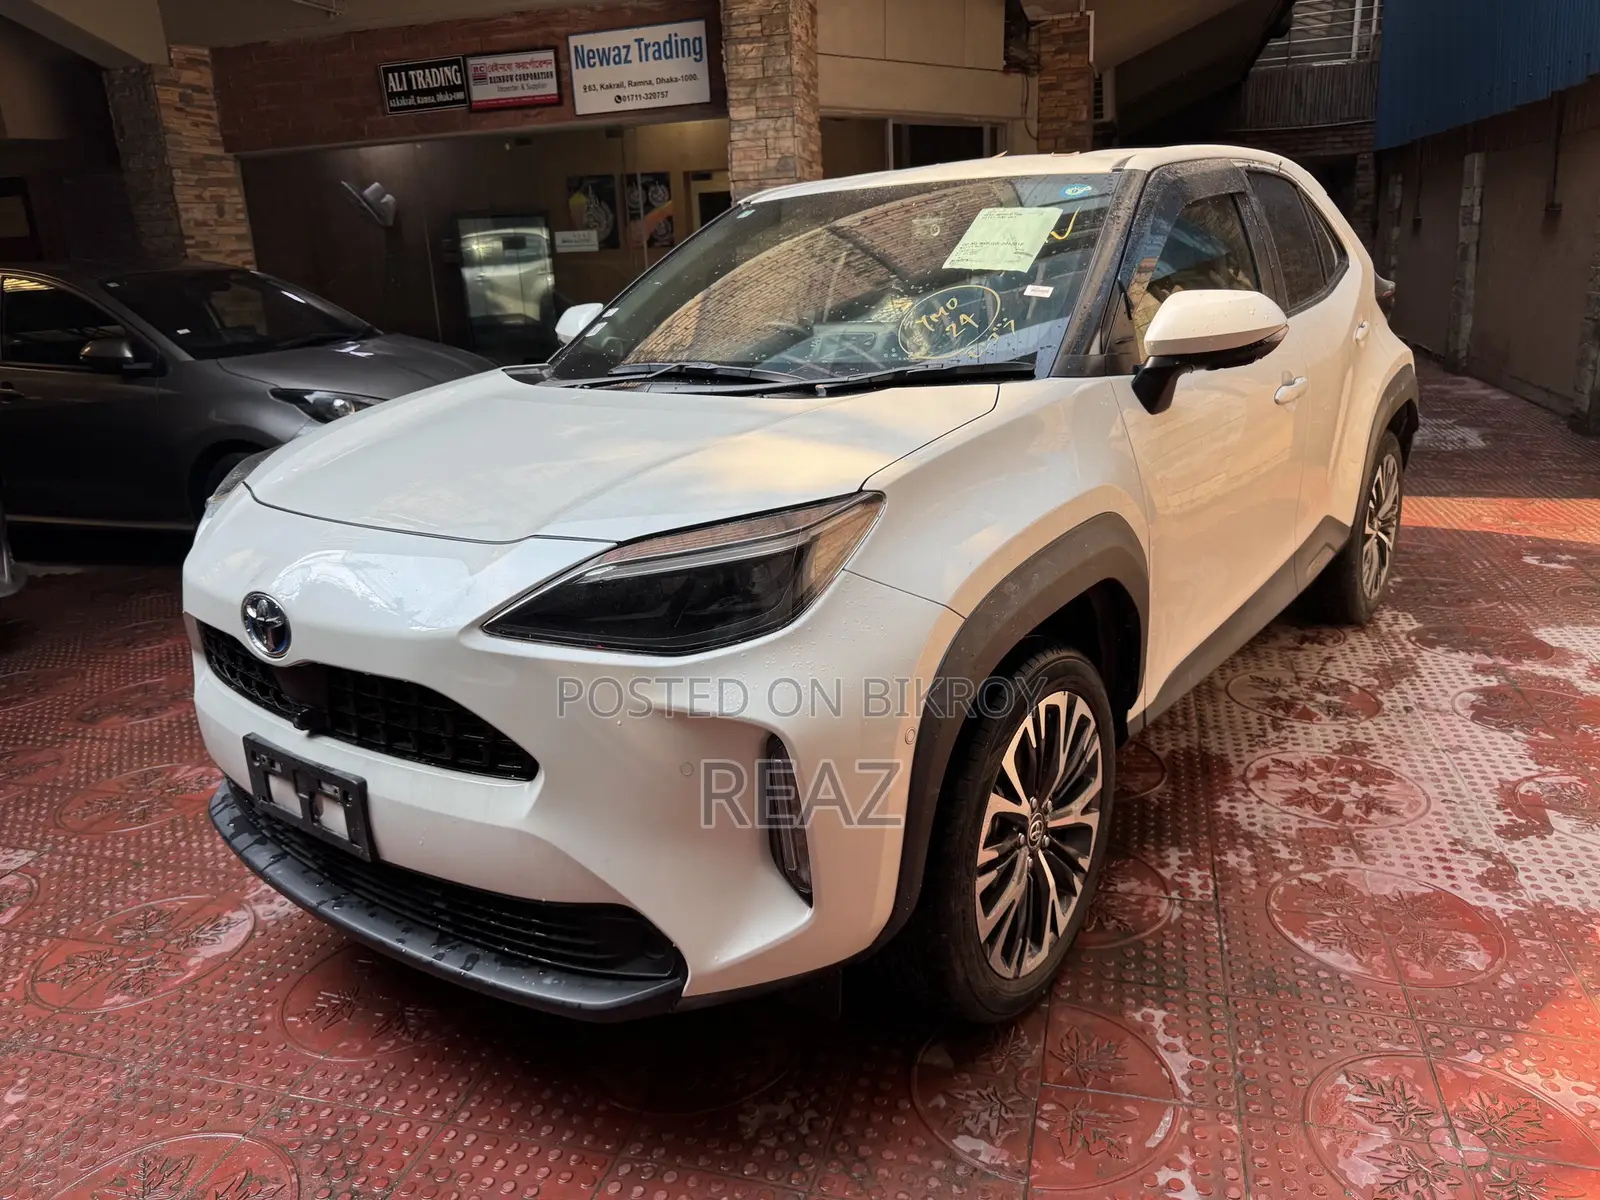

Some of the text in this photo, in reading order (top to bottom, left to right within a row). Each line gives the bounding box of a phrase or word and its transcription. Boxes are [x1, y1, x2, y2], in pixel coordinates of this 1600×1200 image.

[574, 33, 703, 69] Newaz Trading
[388, 65, 462, 92] ALI TRADING
[489, 71, 554, 84] RAINBOW CORPORATION
[628, 78, 655, 88] Ramna,
[622, 91, 669, 102] 01711-320757
